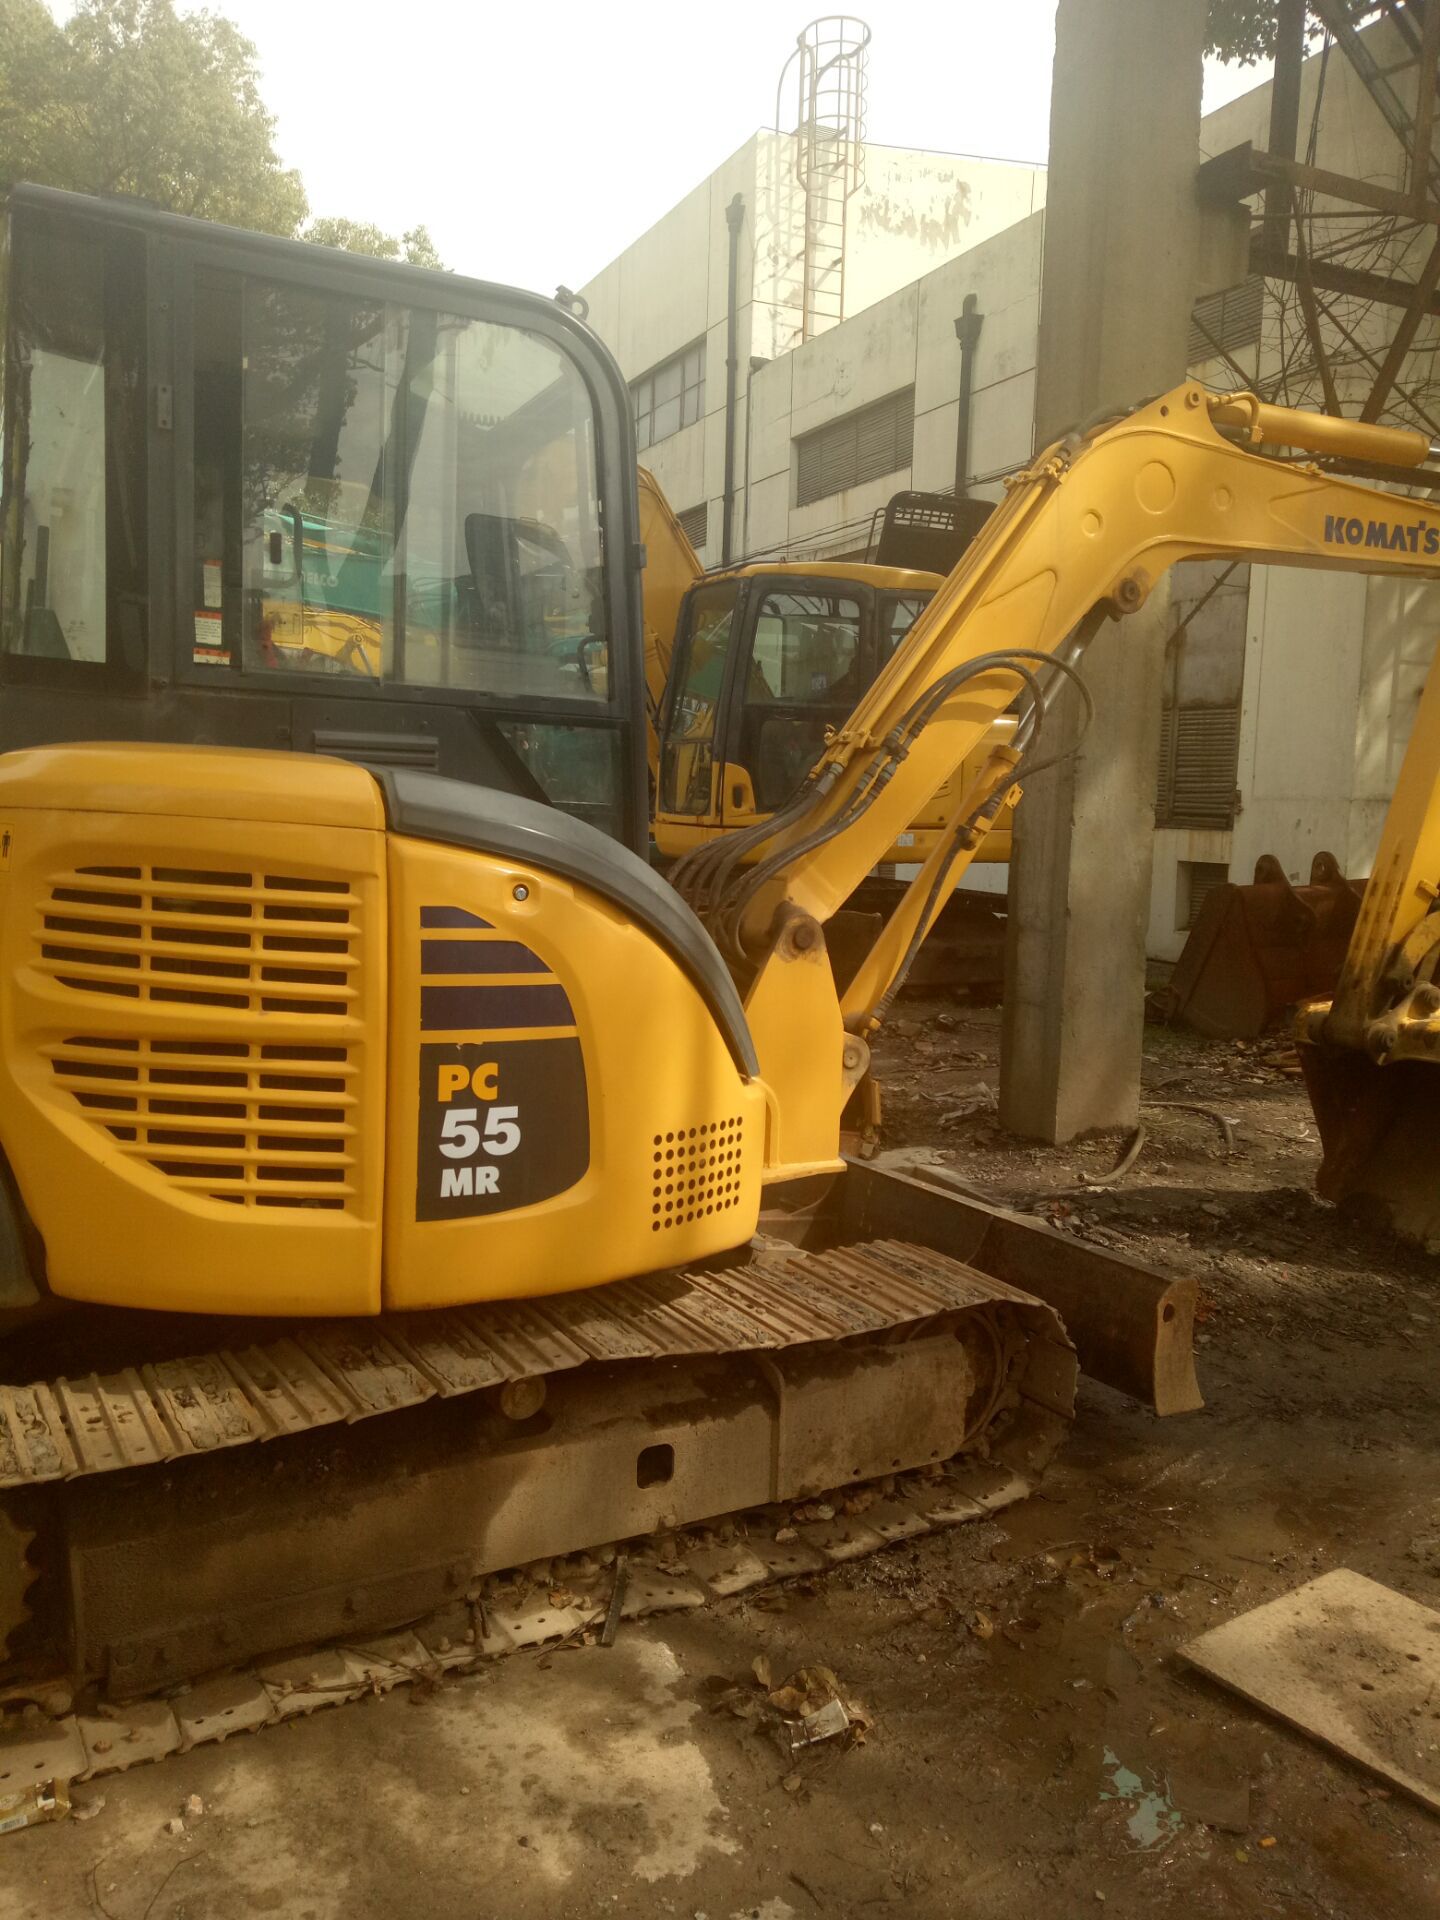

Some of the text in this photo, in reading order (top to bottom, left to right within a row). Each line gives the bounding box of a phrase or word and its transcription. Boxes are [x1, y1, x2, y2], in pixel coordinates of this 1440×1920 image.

[438, 1062, 499, 1102] PC
[438, 1106, 521, 1159] 55
[440, 1166, 500, 1197] MR
